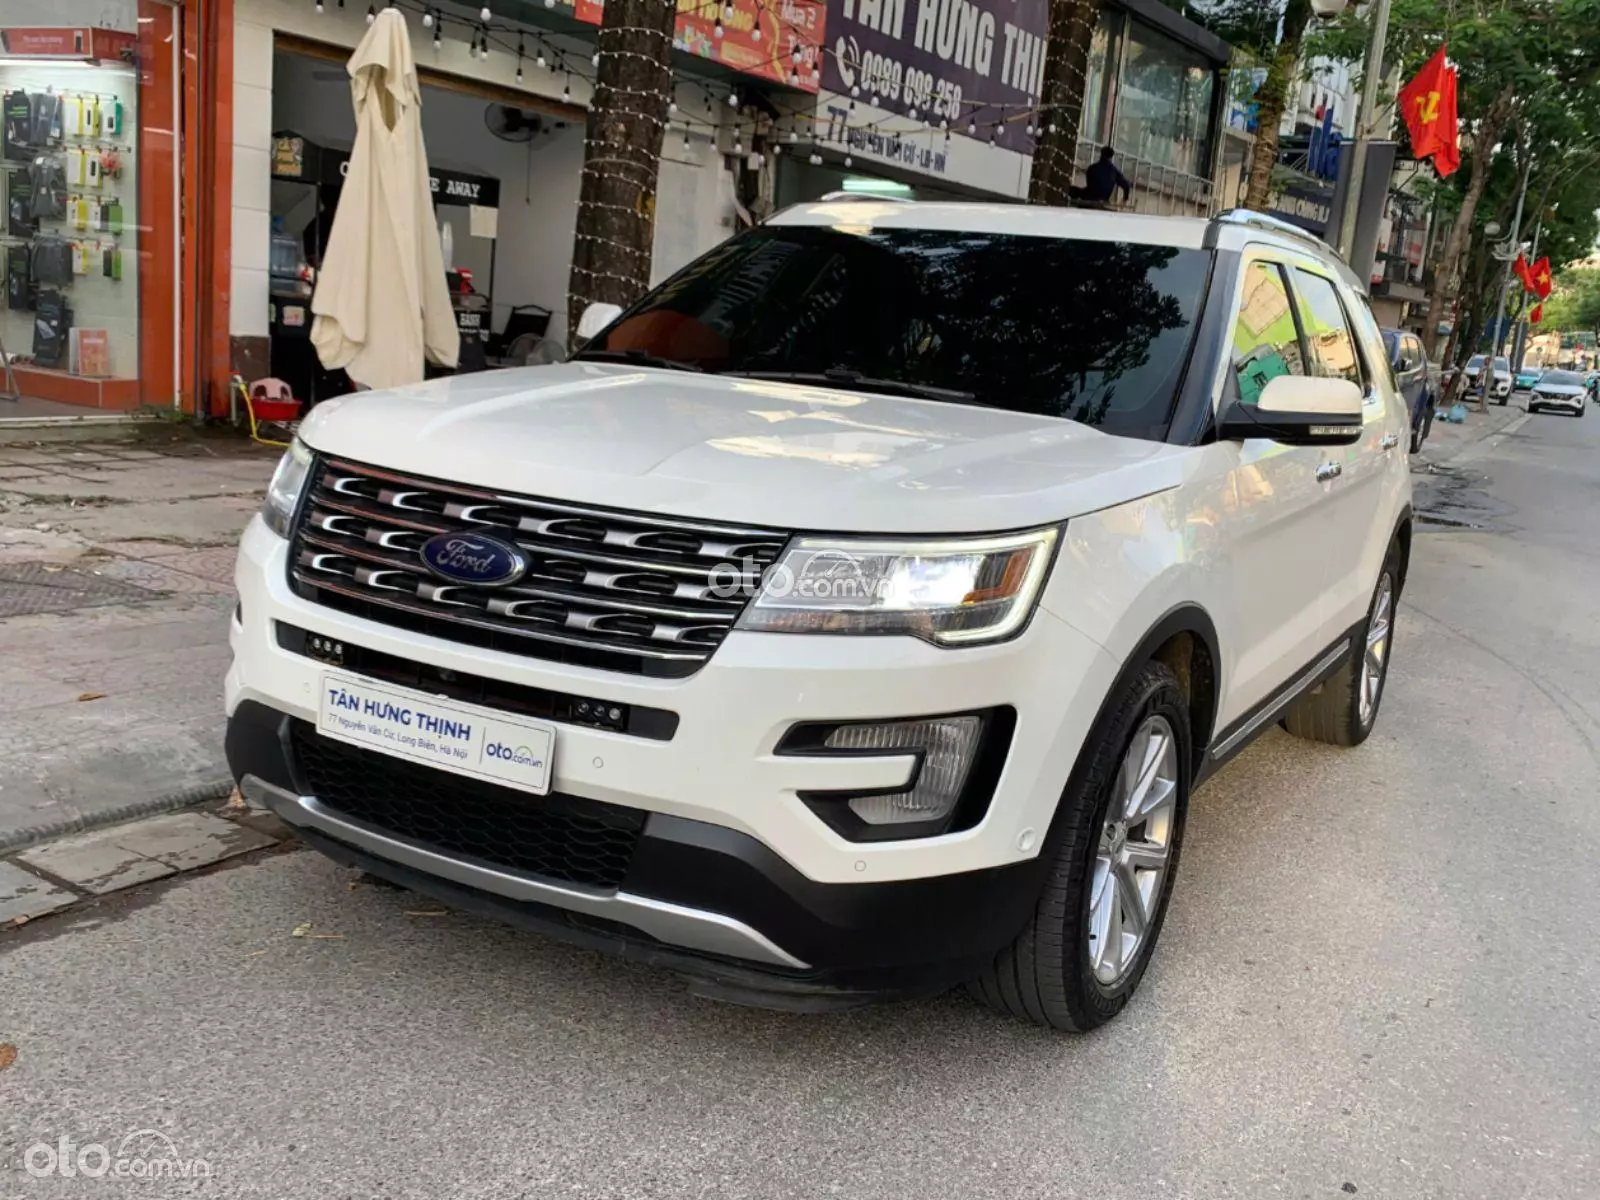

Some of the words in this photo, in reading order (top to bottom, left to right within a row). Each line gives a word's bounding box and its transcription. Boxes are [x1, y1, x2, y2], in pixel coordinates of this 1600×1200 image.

[933, 78, 962, 120] 258
[827, 105, 848, 144] 77
[446, 180, 481, 198] AWAY
[436, 539, 496, 573] Ford
[328, 688, 360, 712] TÂN
[364, 699, 412, 726] HƯNG
[416, 713, 472, 741] THỊNH
